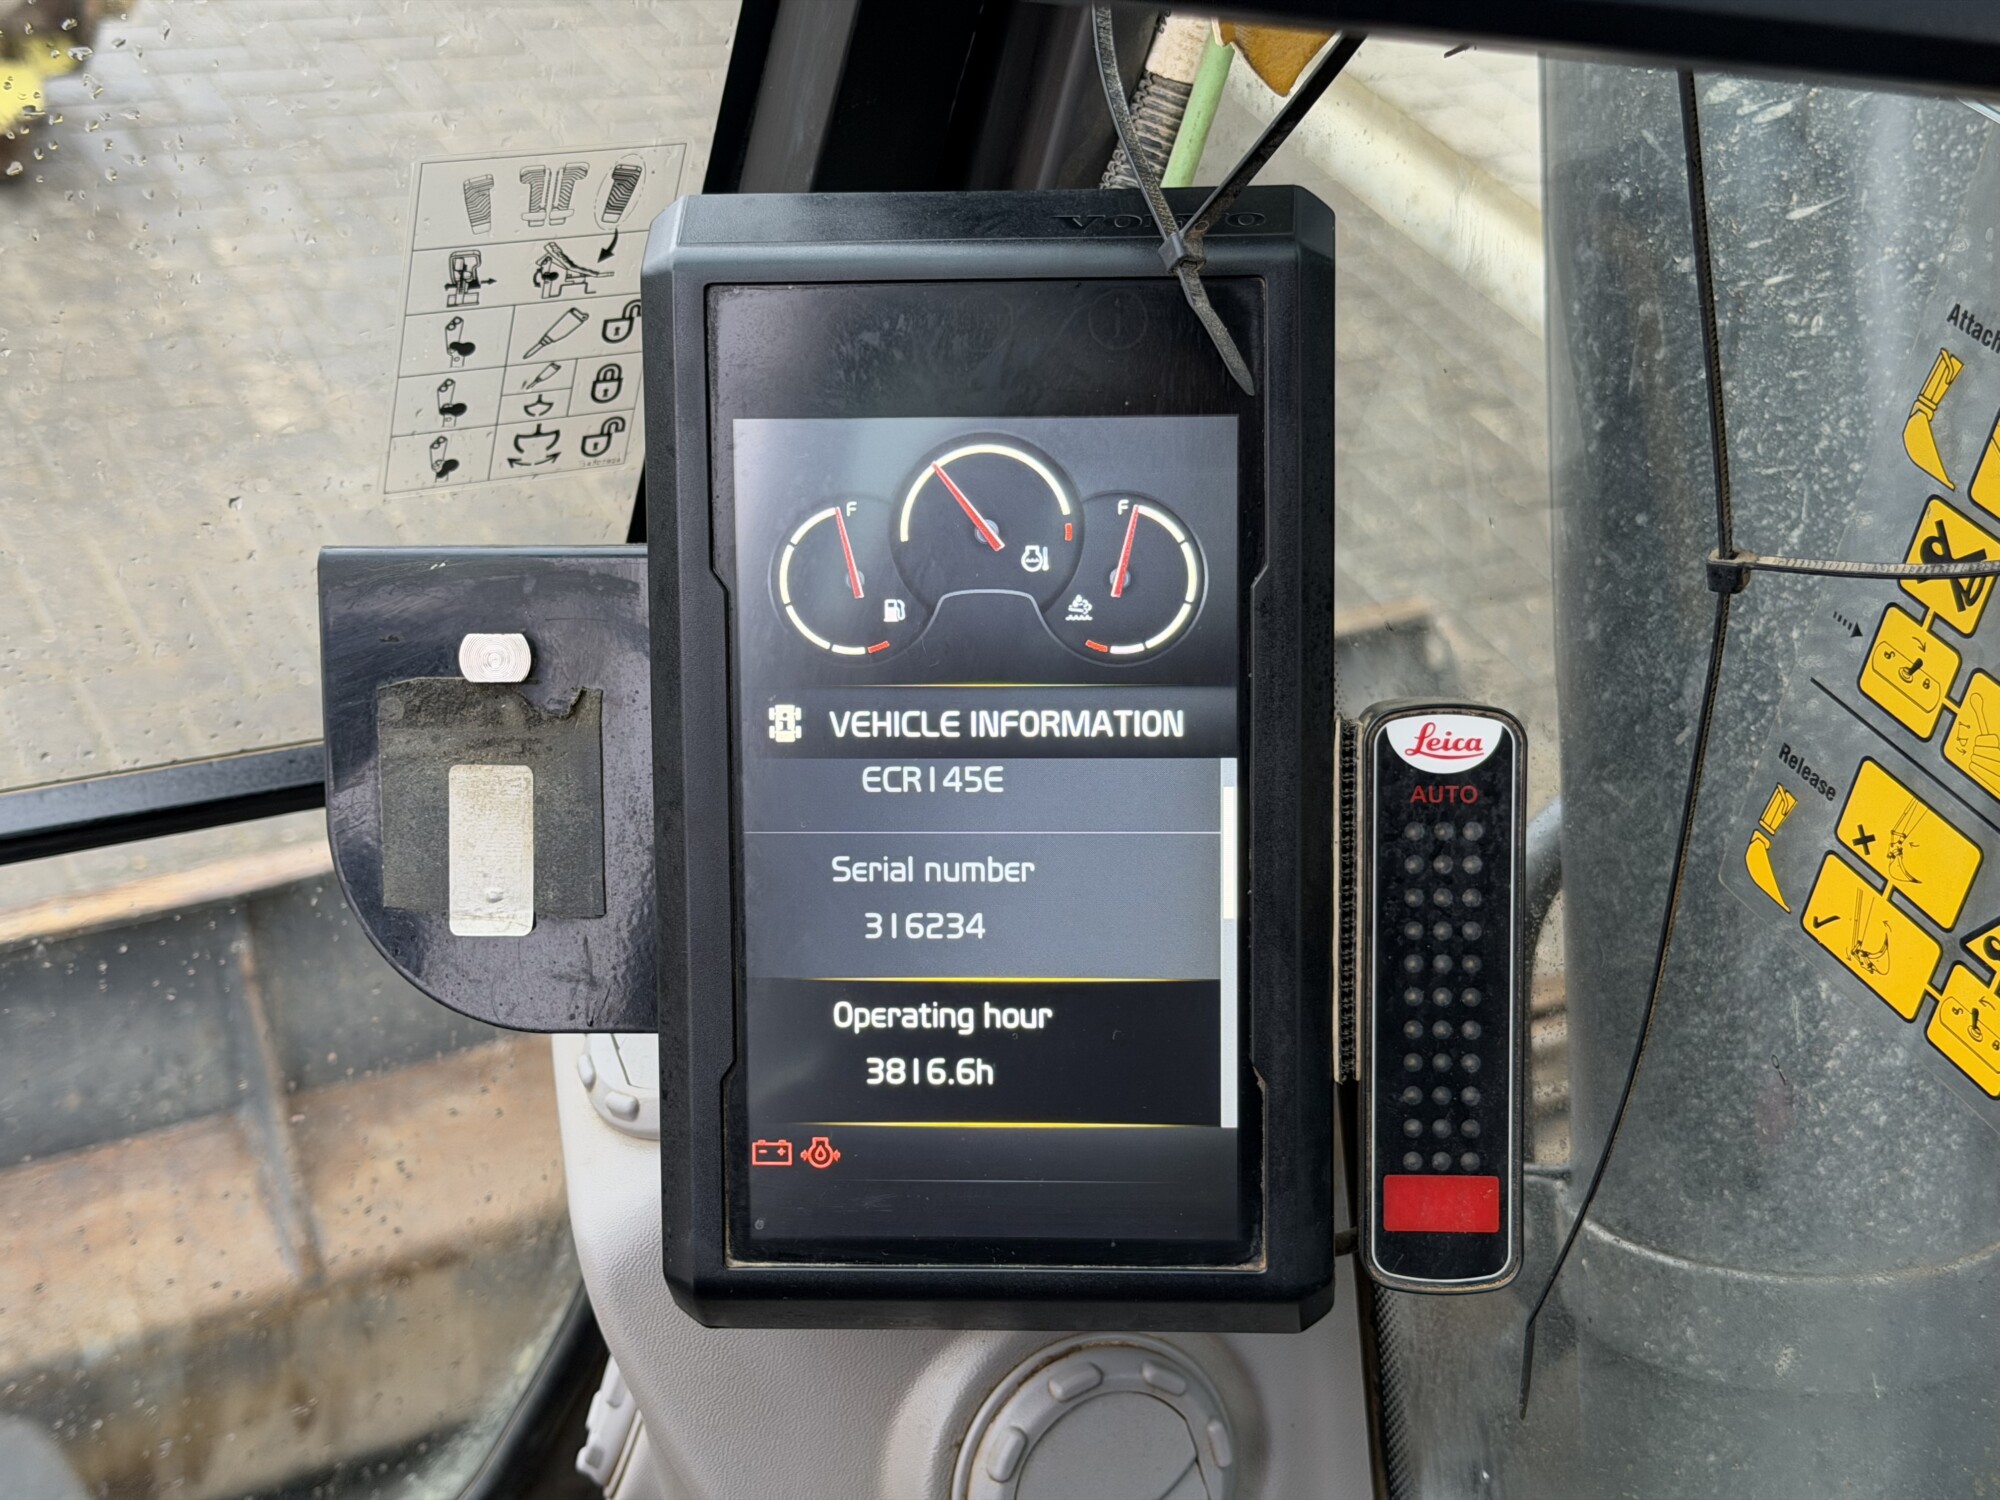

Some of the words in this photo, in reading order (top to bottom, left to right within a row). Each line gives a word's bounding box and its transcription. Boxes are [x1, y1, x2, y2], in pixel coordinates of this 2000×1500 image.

[846, 501, 858, 517] F
[1117, 499, 1130, 516] F
[829, 709, 961, 739] VEHICLE
[970, 709, 1185, 739] INFORMATION
[1404, 721, 1485, 760] Leica
[862, 765, 1005, 794] ECR145E
[1778, 741, 1837, 802] Release
[1409, 784, 1479, 805] AUTO
[831, 855, 914, 883] Serial
[925, 855, 1036, 883] number
[864, 912, 986, 940] 316234
[833, 1000, 974, 1036] Operating
[983, 1000, 1053, 1031] hour
[866, 1056, 994, 1086] 3816.6h
